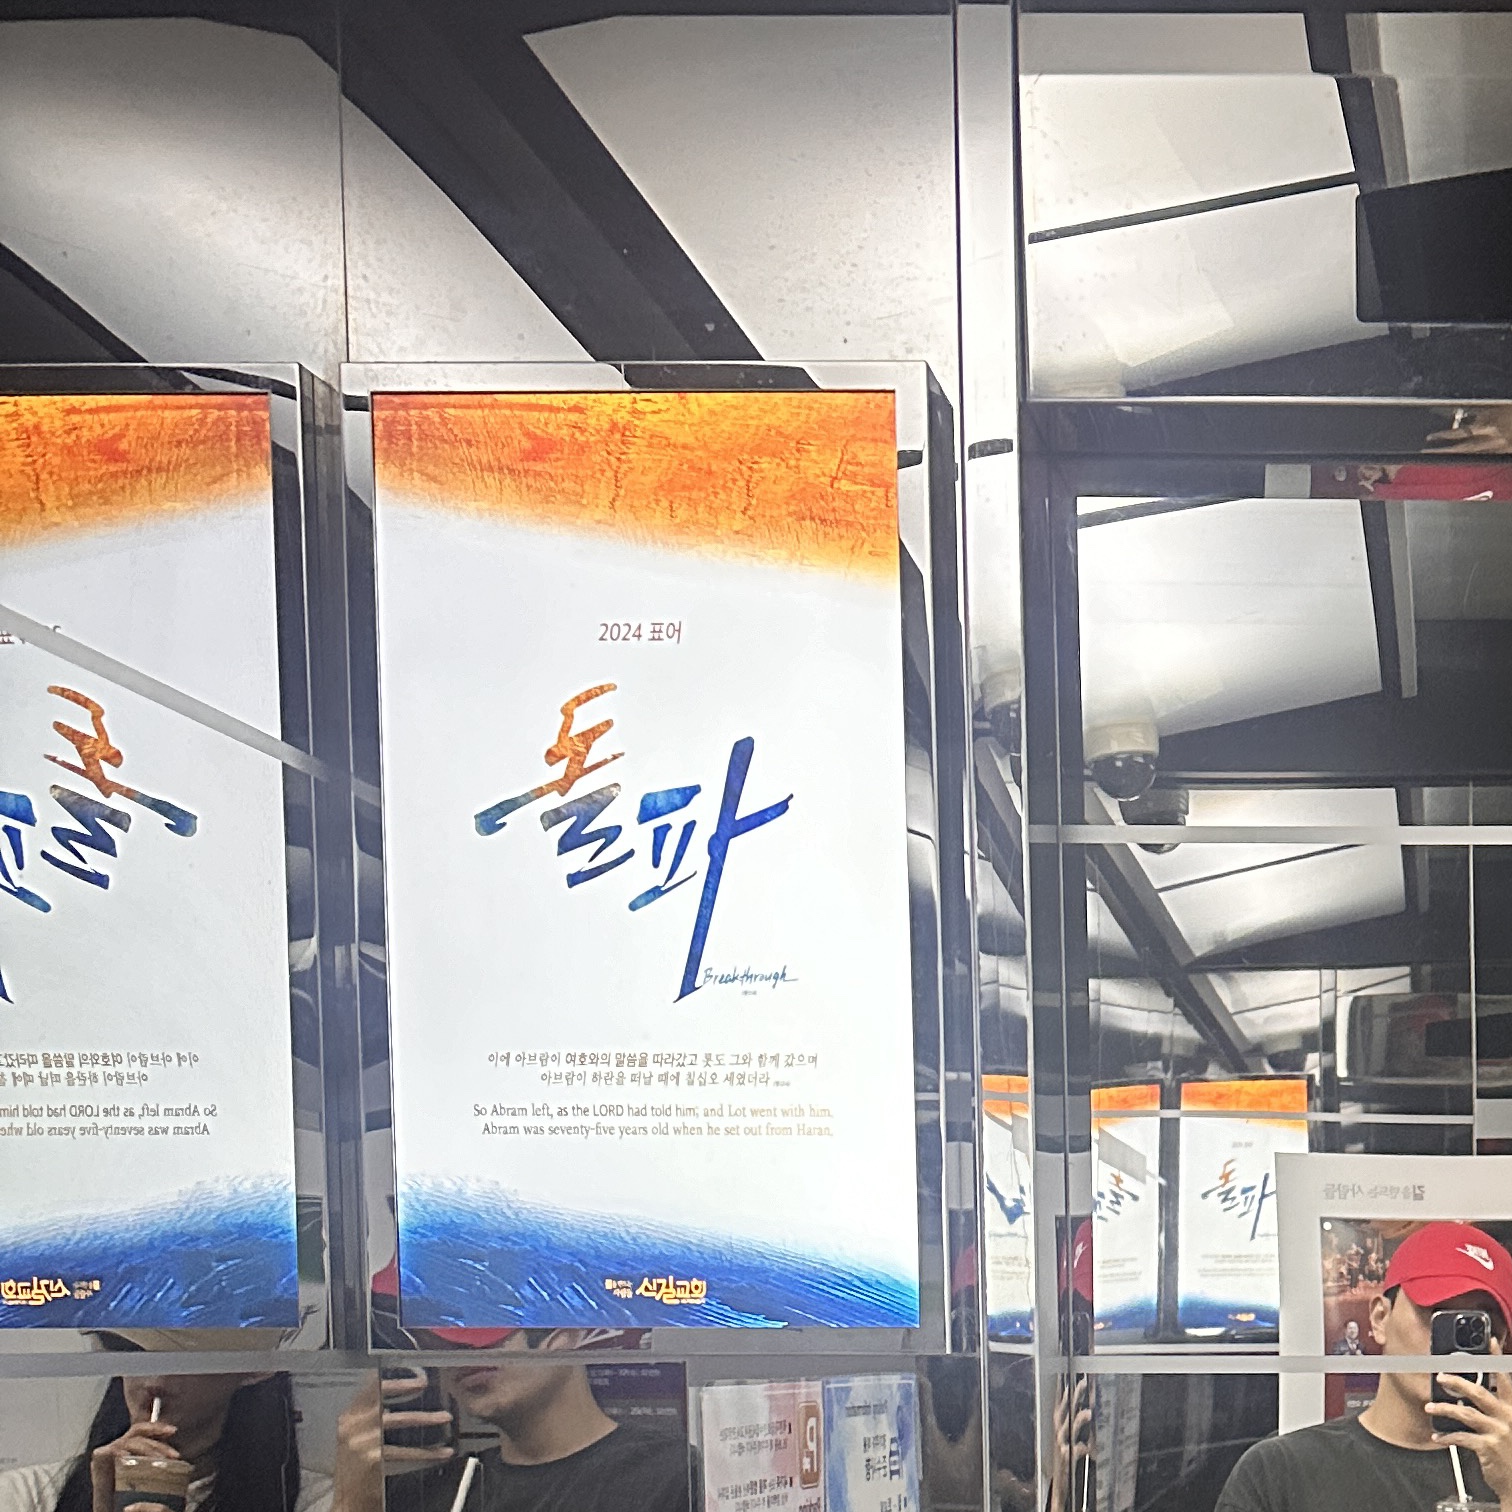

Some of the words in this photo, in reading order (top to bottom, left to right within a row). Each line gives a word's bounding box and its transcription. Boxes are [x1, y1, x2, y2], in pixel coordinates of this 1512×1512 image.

[598, 621, 642, 642] 2024
[647, 620, 682, 645] 표어
[474, 682, 794, 1004] 돌파
[701, 964, 799, 990] Breakthrough
[487, 1052, 511, 1069] 이에
[515, 1052, 561, 1068] 아브람이
[565, 1052, 612, 1069] 여호와의
[615, 1052, 649, 1068] 말씀을
[652, 1053, 698, 1069] 따라갔고
[729, 1053, 753, 1068] 그와
[540, 1071, 587, 1088] 아브람이
[591, 1071, 626, 1088] 하란을
[630, 1071, 654, 1088] 떠날
[473, 1103, 488, 1117] So
[491, 1103, 528, 1118] Abram
[531, 1103, 554, 1119] left,
[556, 1106, 569, 1118] as
[571, 1103, 590, 1118] the
[593, 1104, 624, 1117] LORD
[627, 1103, 647, 1117] had
[650, 1103, 672, 1117] told
[703, 1103, 724, 1117] and
[727, 1104, 747, 1117] Lot
[750, 1106, 778, 1118] went
[780, 1103, 805, 1118] with
[481, 1121, 519, 1136] Abram
[522, 1124, 545, 1136] was
[547, 1121, 616, 1138] seventy-five
[618, 1124, 649, 1139] years
[651, 1121, 670, 1136] old
[672, 1122, 704, 1137] when
[706, 1122, 721, 1137] he
[723, 1123, 741, 1137] set
[743, 1123, 762, 1137] out
[765, 1121, 793, 1136] from
